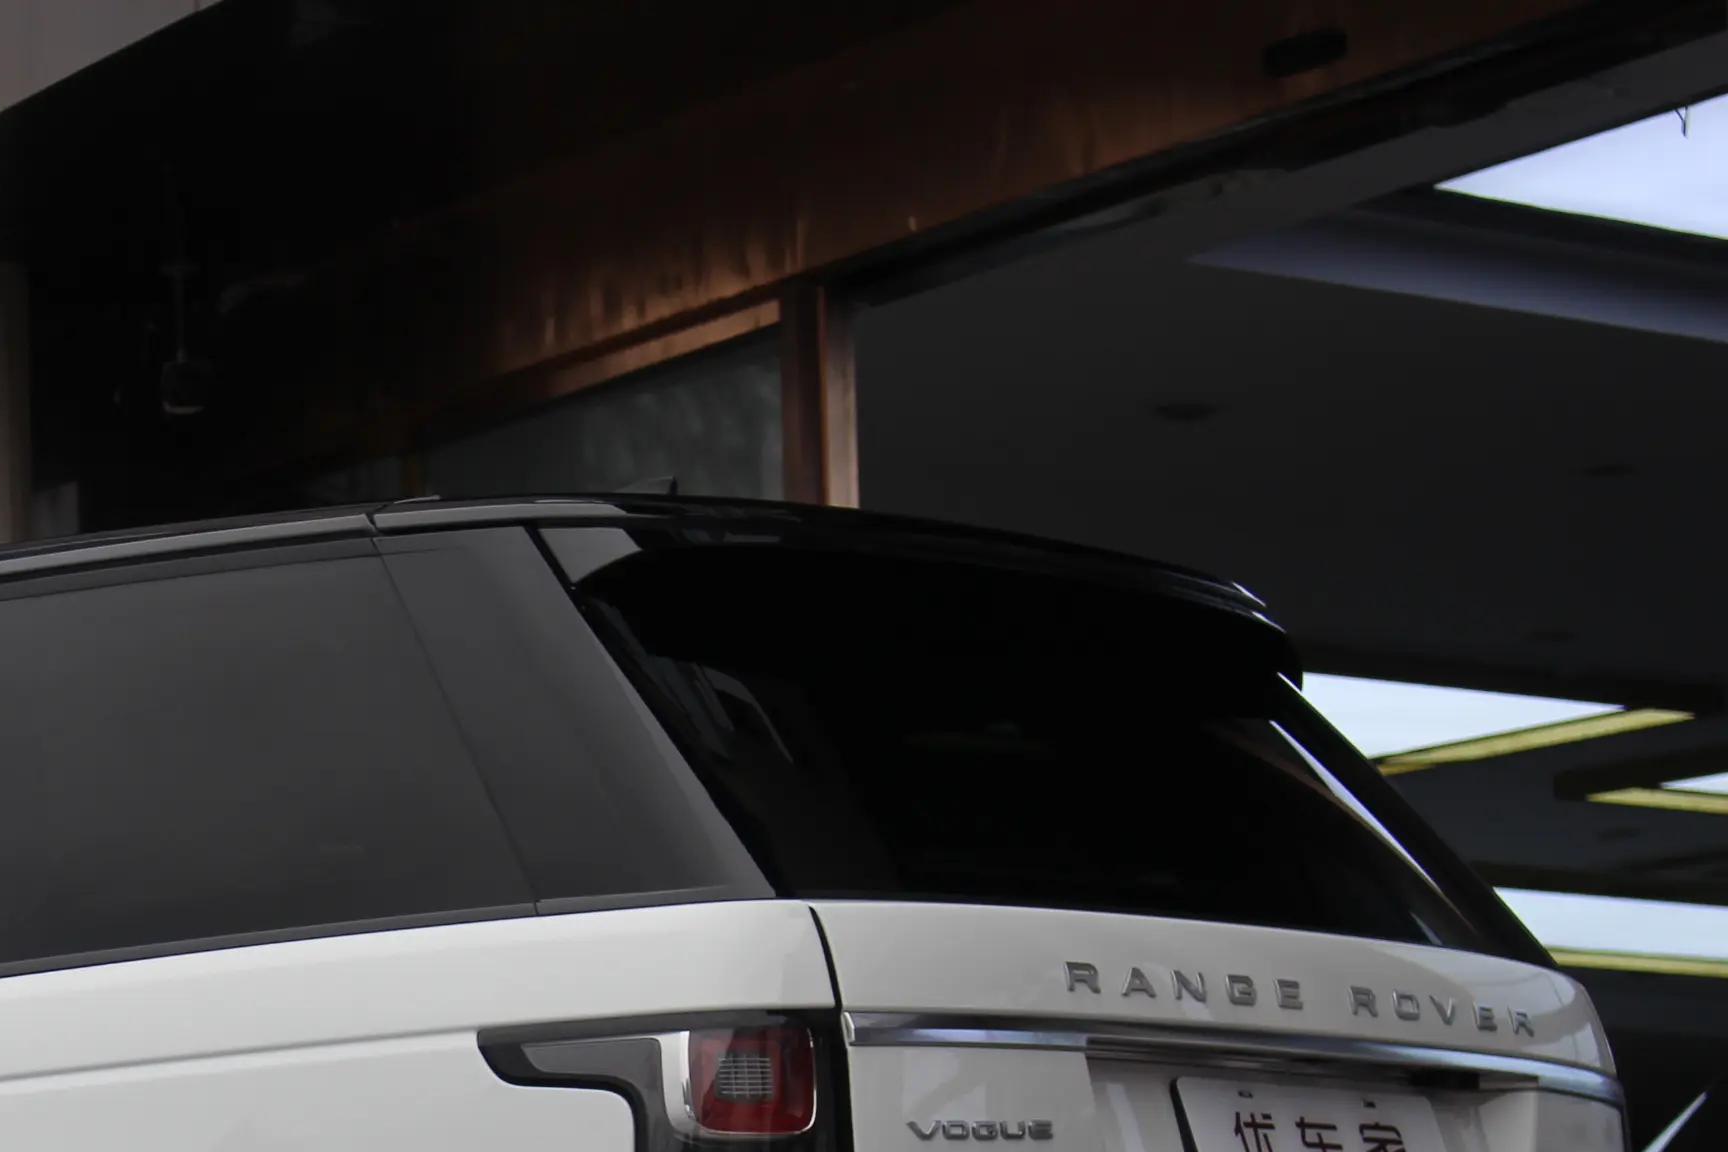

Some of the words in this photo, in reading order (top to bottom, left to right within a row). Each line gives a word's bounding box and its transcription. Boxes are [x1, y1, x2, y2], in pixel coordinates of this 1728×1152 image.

[1062, 961, 1303, 1010] RANGE
[1347, 985, 1535, 1037] ROVER
[906, 1119, 1054, 1141] VOGUE
